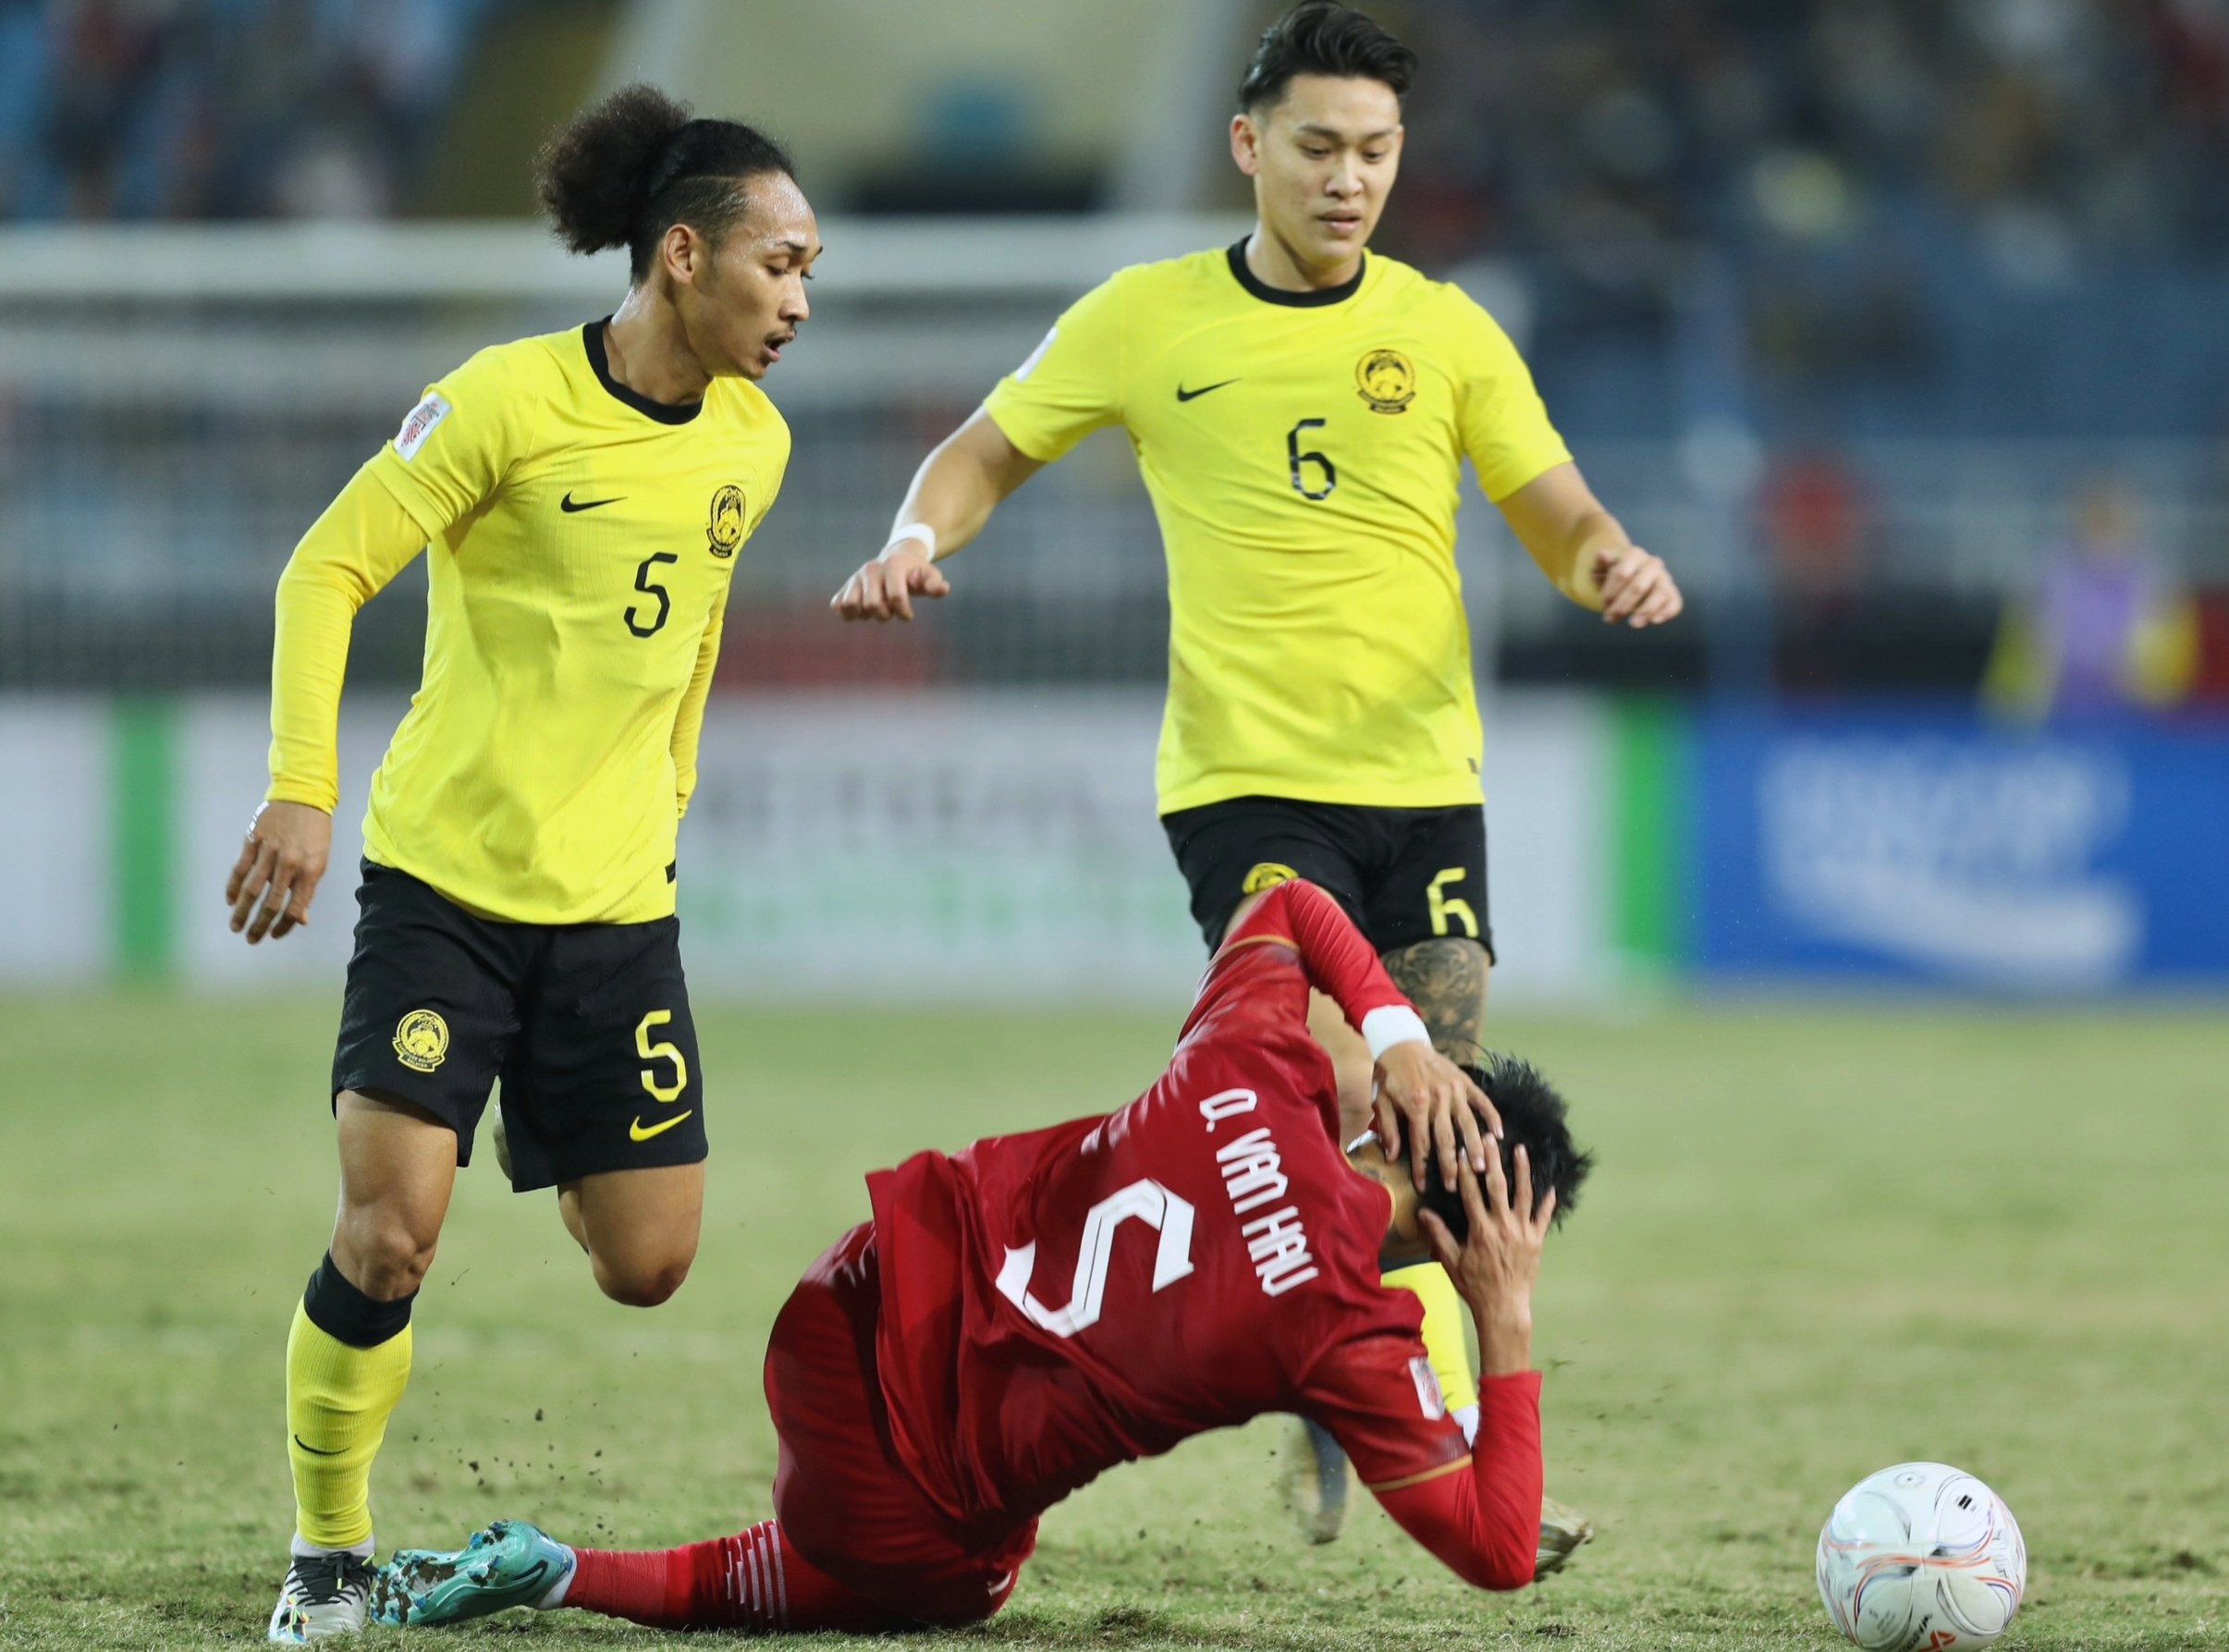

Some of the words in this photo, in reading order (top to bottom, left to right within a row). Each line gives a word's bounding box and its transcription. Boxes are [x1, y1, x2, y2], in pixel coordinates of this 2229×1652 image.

[1287, 418, 1336, 500] 6
[624, 552, 677, 638] 5
[1427, 867, 1479, 937] 6
[635, 1010, 687, 1102] 5
[1216, 1127, 1288, 1215] VAN
[996, 1178, 1194, 1339] 5
[1242, 1205, 1319, 1297] HAU
